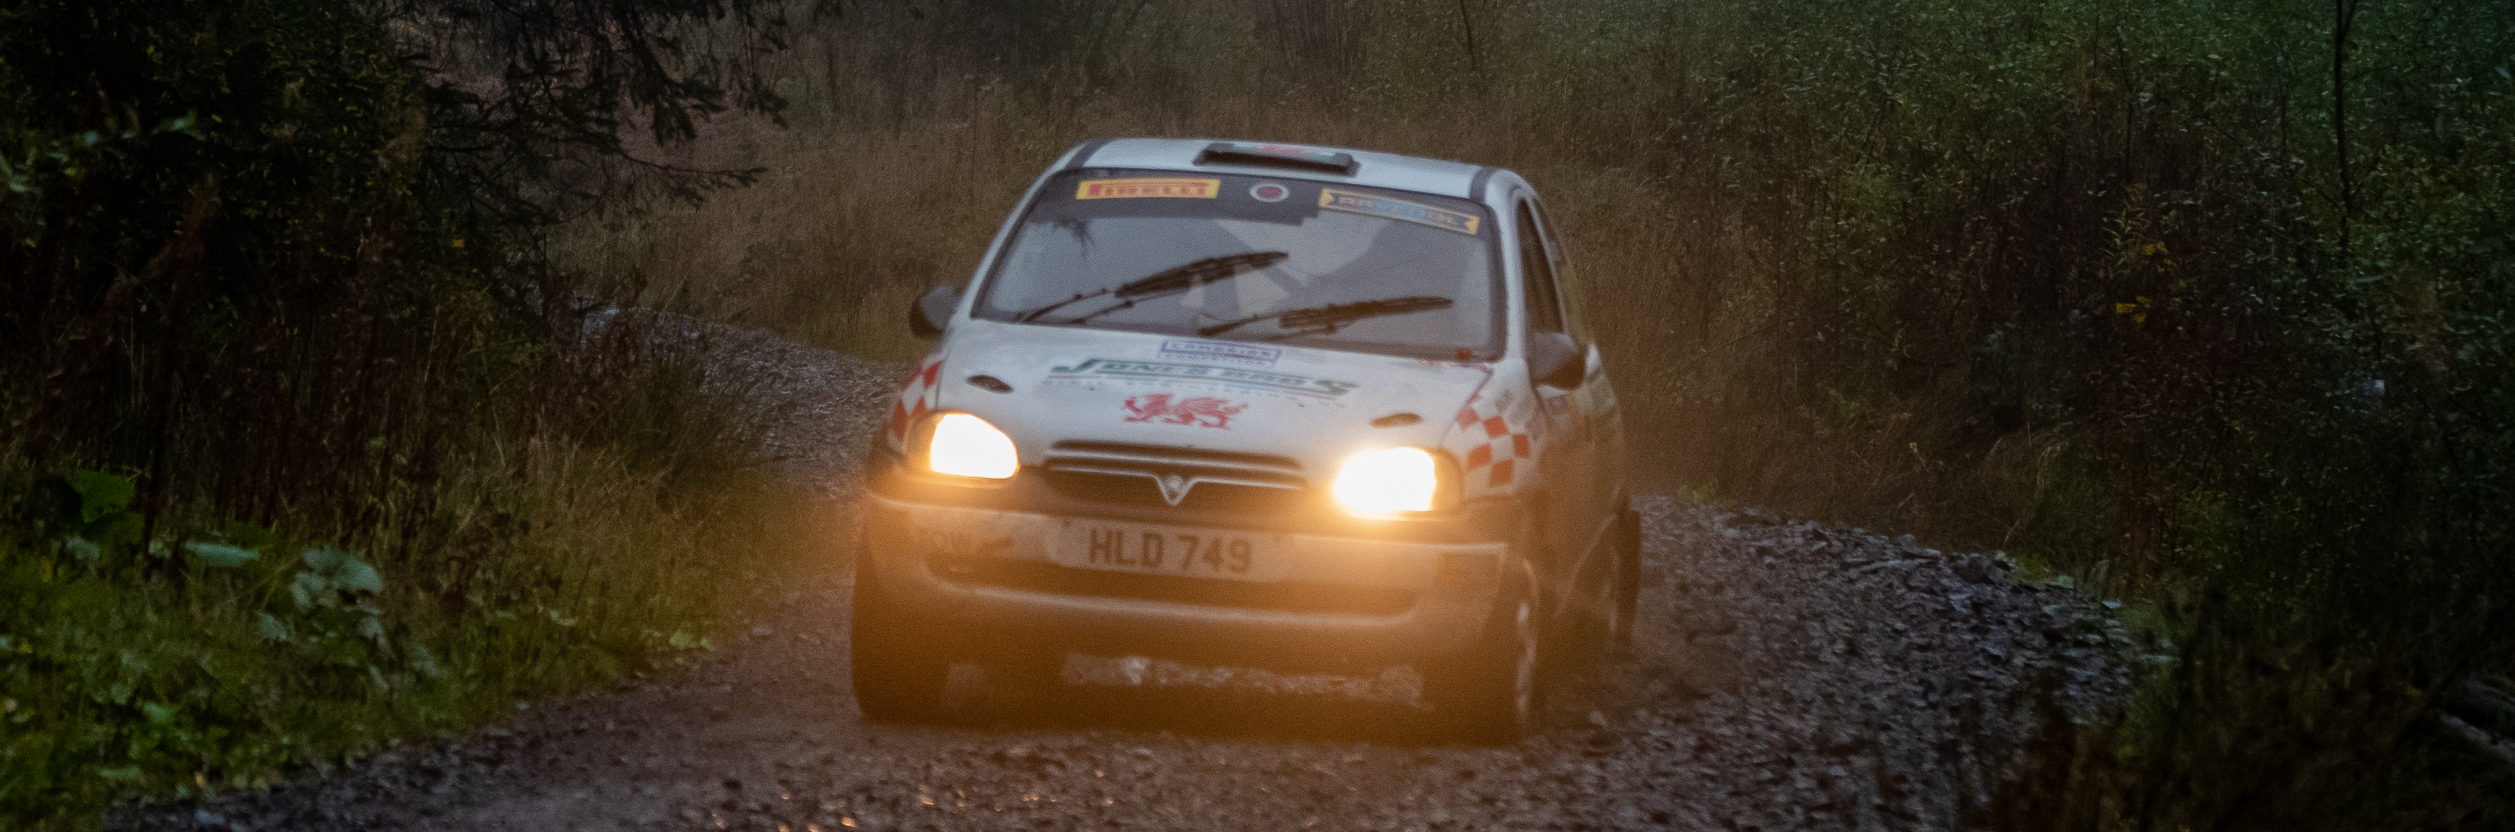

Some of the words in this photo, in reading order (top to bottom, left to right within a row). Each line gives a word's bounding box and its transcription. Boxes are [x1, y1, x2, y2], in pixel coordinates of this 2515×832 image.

[1086, 179, 1210, 198] PIRELLI
[1088, 528, 1164, 568] HLD
[1175, 532, 1252, 574] 749
